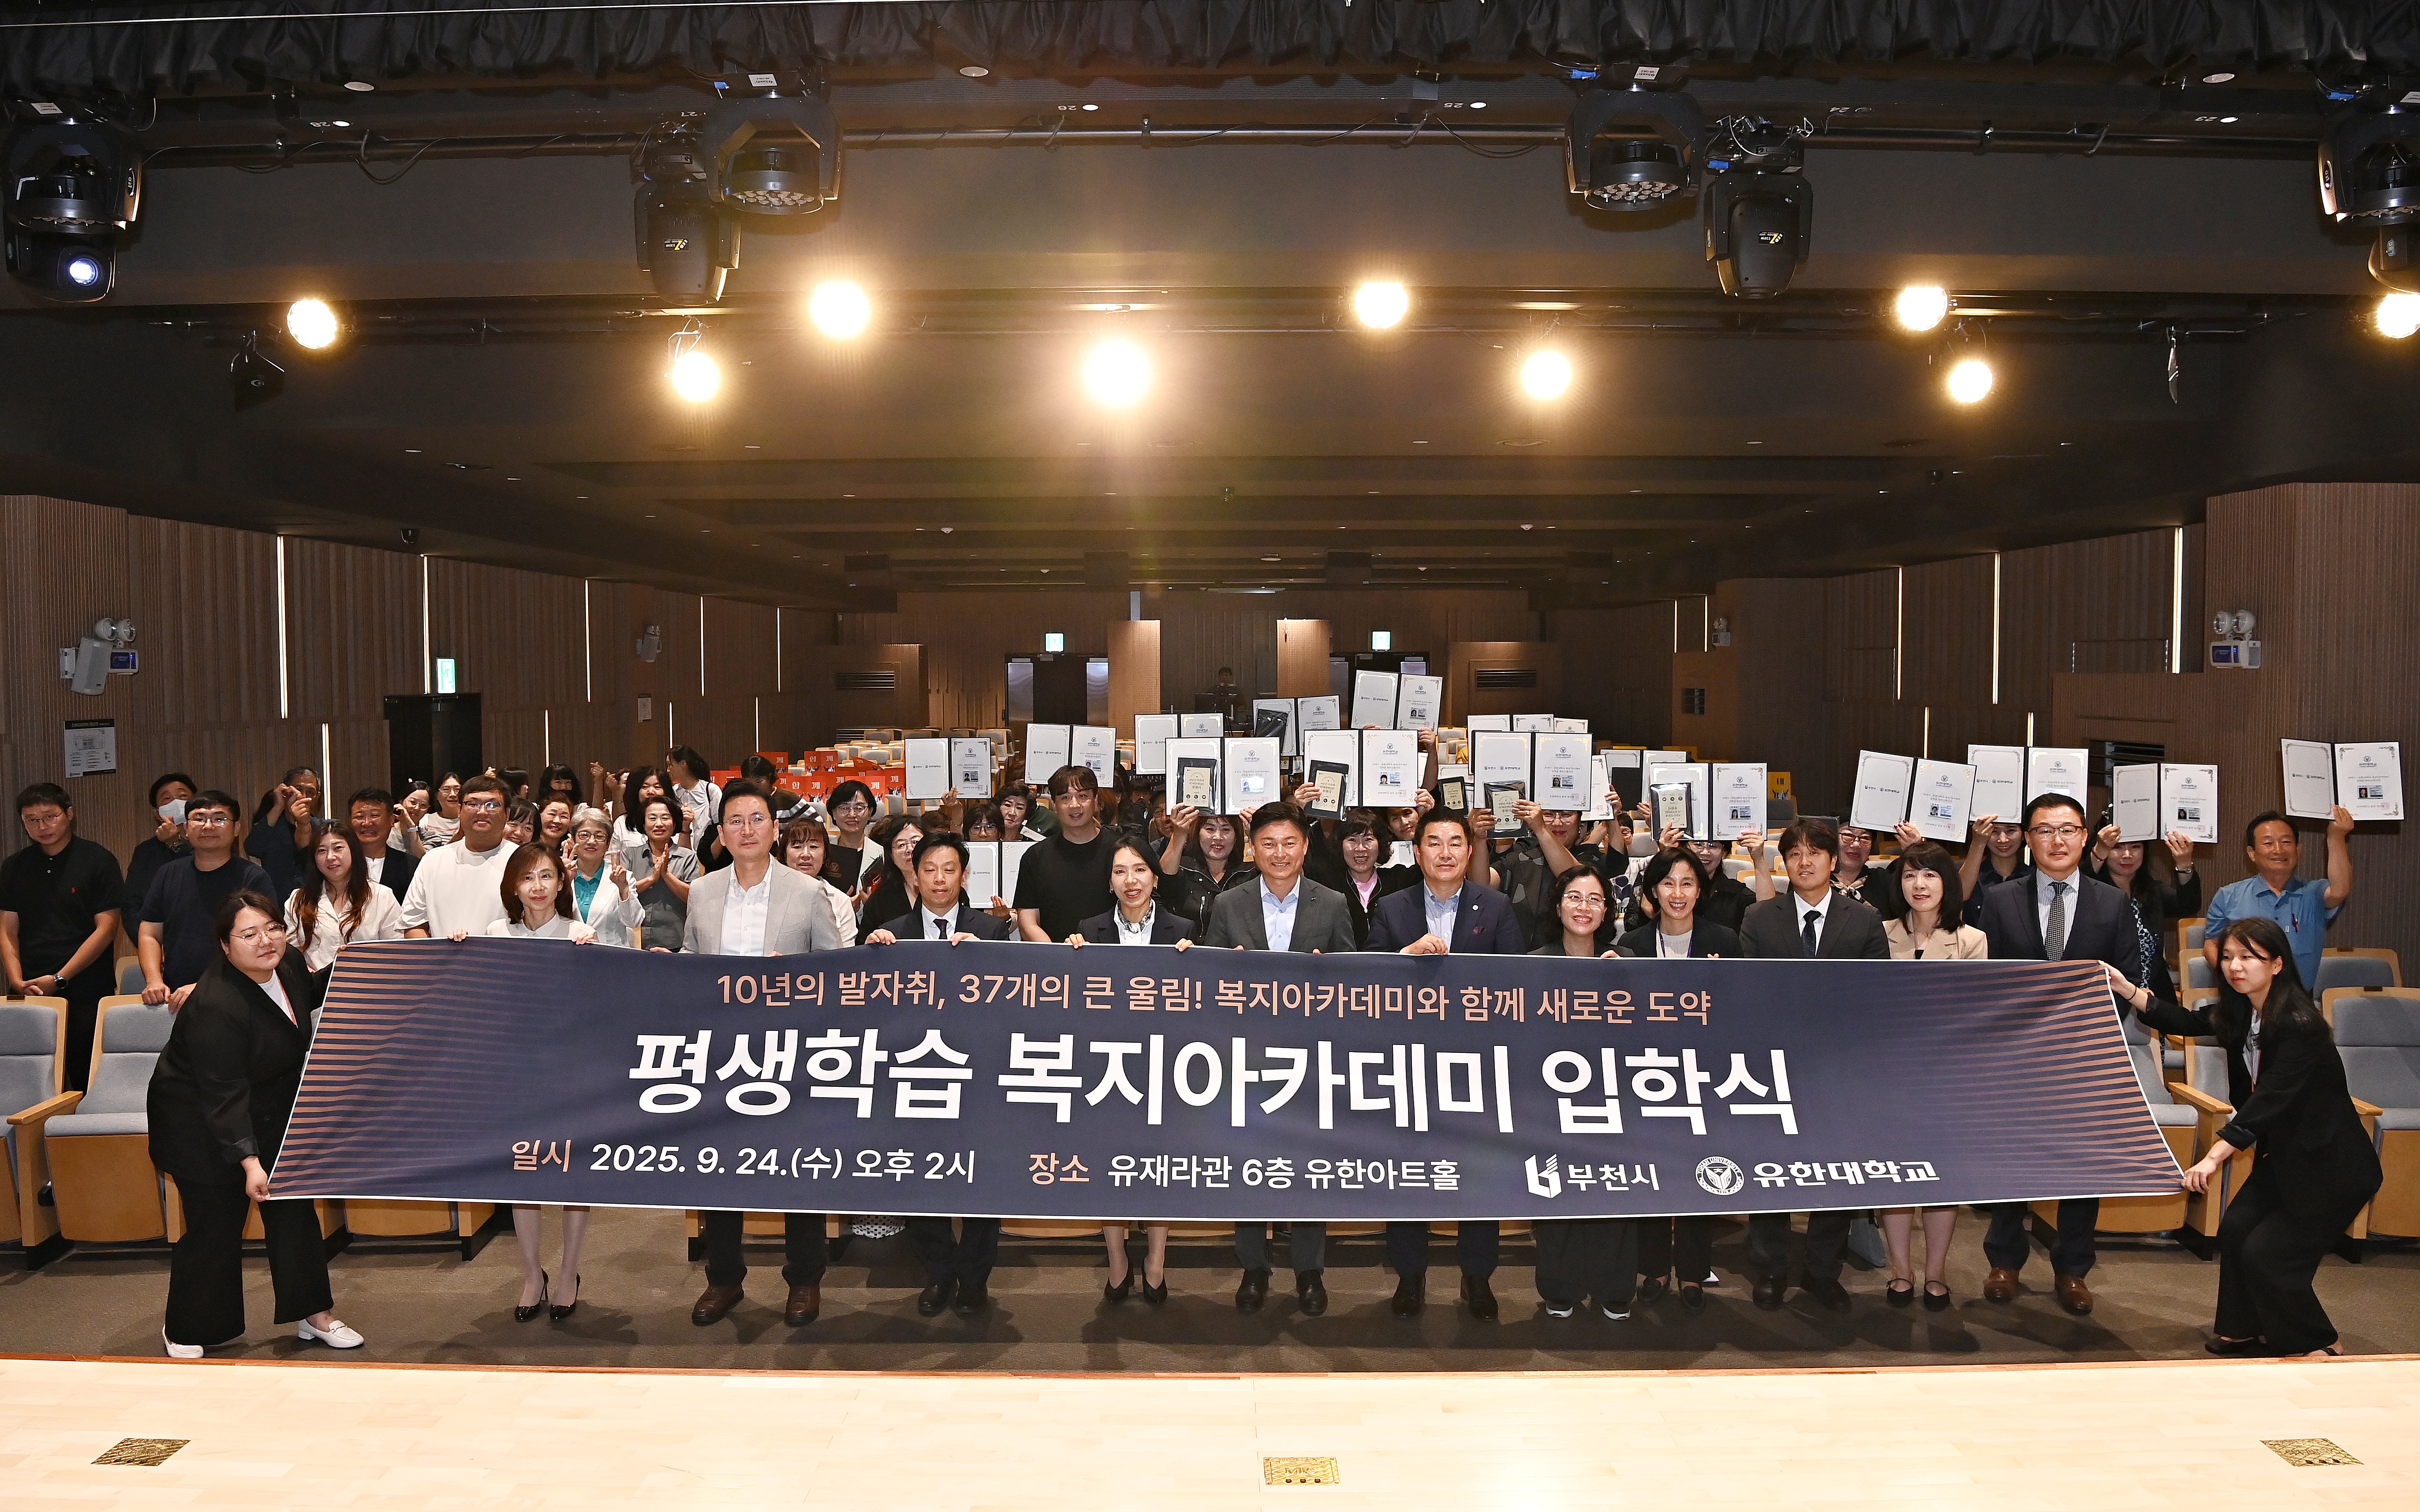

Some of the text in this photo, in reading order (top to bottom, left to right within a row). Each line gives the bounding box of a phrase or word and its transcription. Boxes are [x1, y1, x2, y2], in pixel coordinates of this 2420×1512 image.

[680, 239, 688, 249] LED
[717, 971, 1711, 1025] 10년의 발자취, 37개의 큰 울림! 복지아카데미와 함께 새로운 도약
[629, 1029, 1799, 1135] 평생학습 복지아카데미 입학식
[512, 1139, 975, 1183] 일시 2025. 9. 24.(수) 오후 2시
[1029, 1153, 1460, 1191] 장소 유재라관 6층 유한아트홀
[1567, 1164, 1660, 1191] 부천시
[1697, 1157, 1740, 1173] YUHAN UNIVERSITY
[1753, 1160, 1940, 1188] 유한대학교
